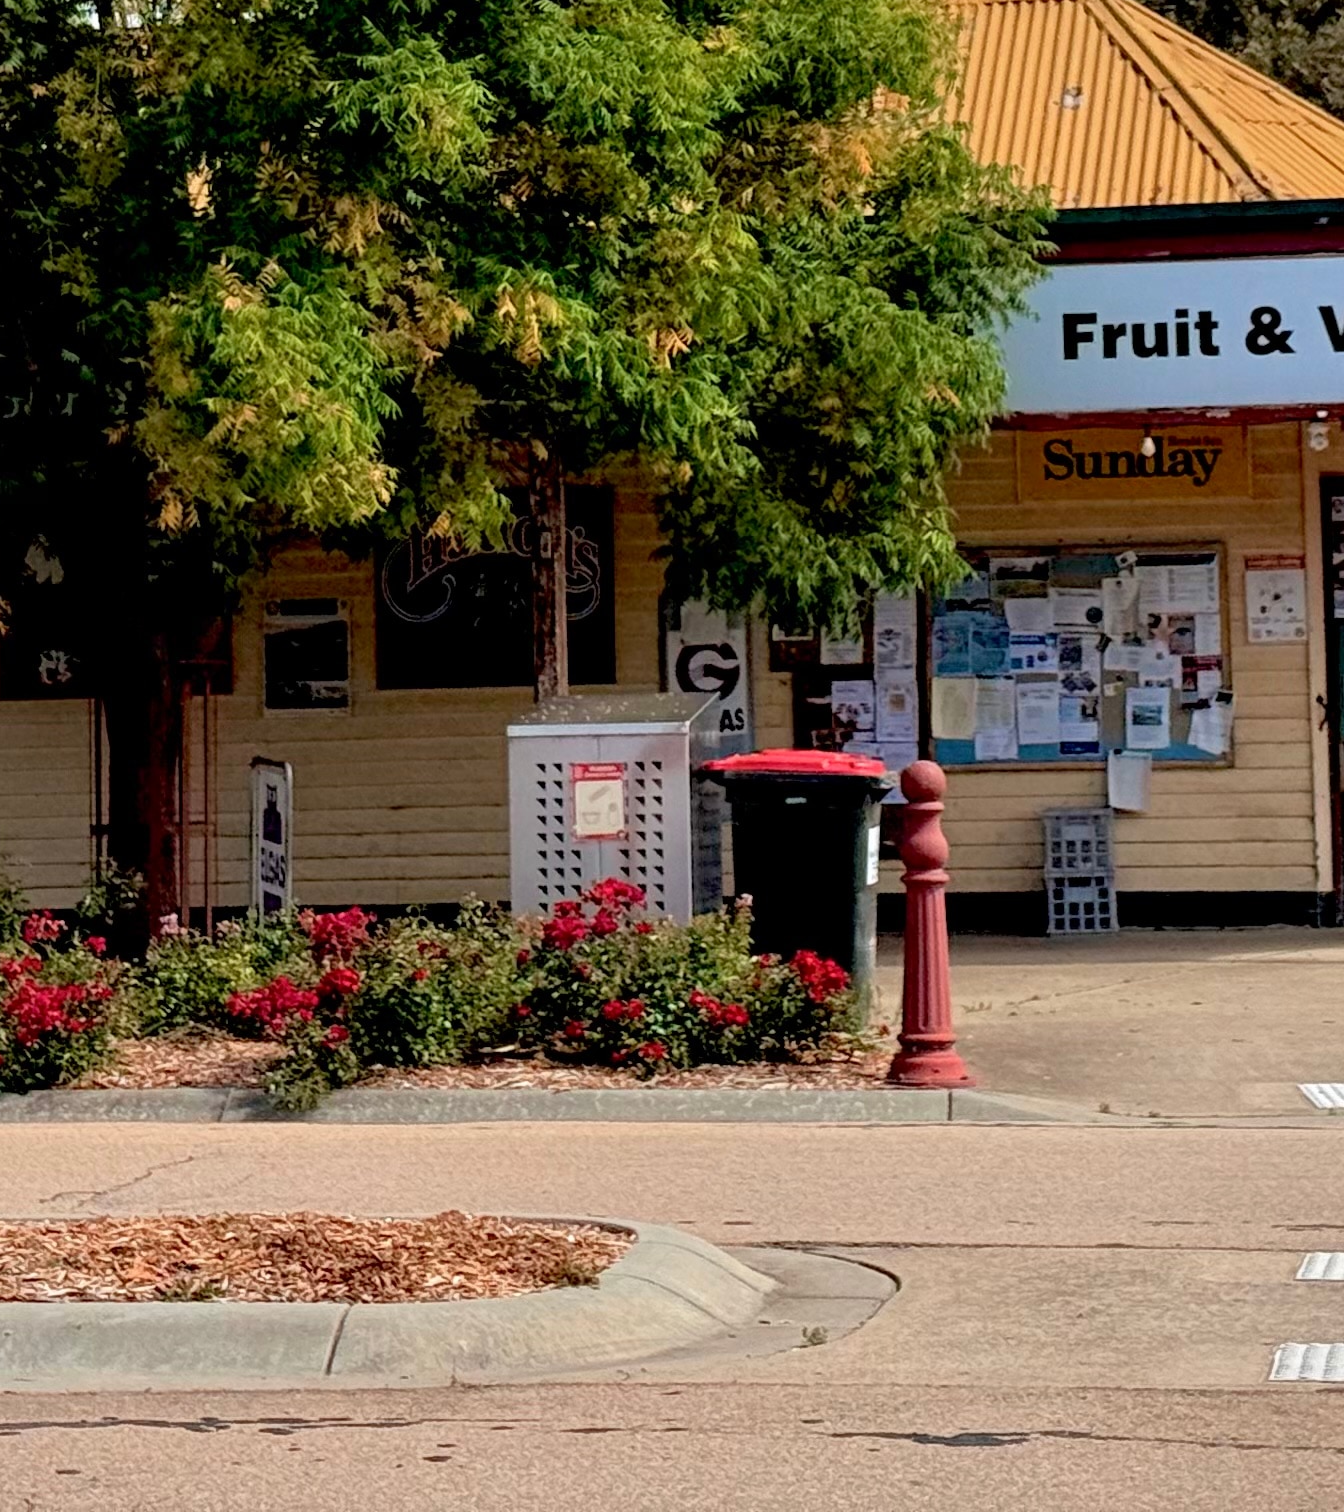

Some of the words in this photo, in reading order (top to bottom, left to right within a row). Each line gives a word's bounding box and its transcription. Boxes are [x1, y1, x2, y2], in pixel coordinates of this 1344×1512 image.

[1062, 308, 1221, 360] Fruit
[1245, 306, 1296, 355] &
[1044, 436, 1223, 487] Sunday
